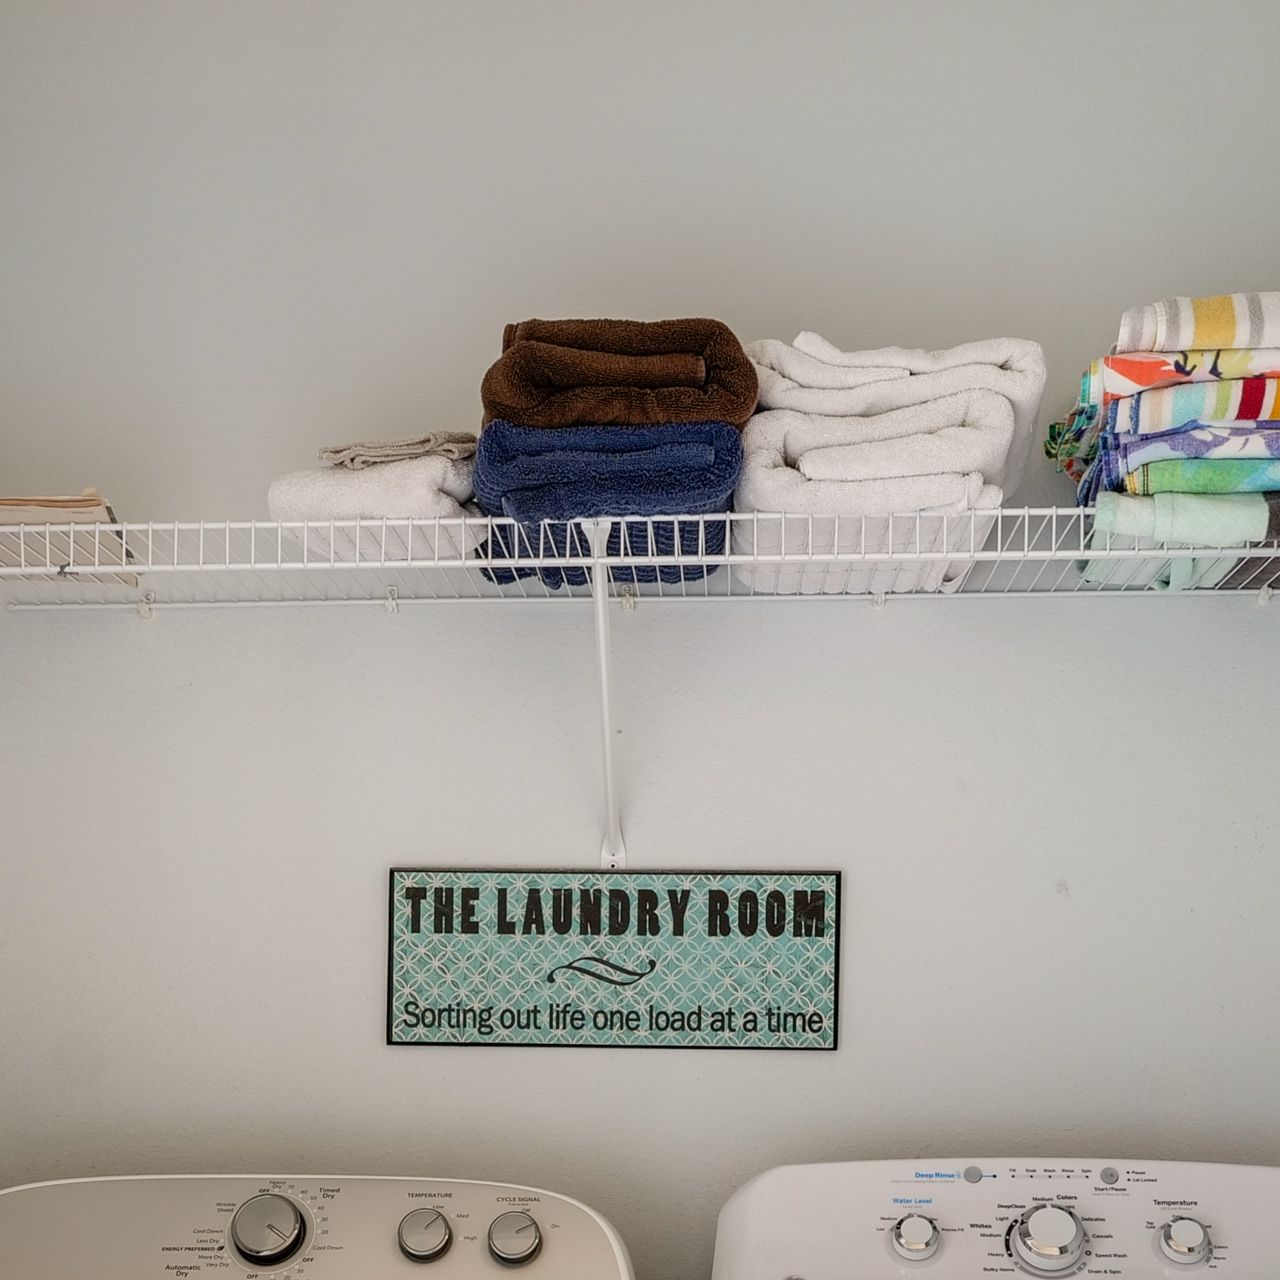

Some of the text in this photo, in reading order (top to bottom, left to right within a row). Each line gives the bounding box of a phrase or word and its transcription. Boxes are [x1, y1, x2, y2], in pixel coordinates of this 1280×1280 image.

[405, 887, 825, 937] THE LAUNDRY ROOM
[403, 1001, 824, 1035] Sorting out life one load at a time
